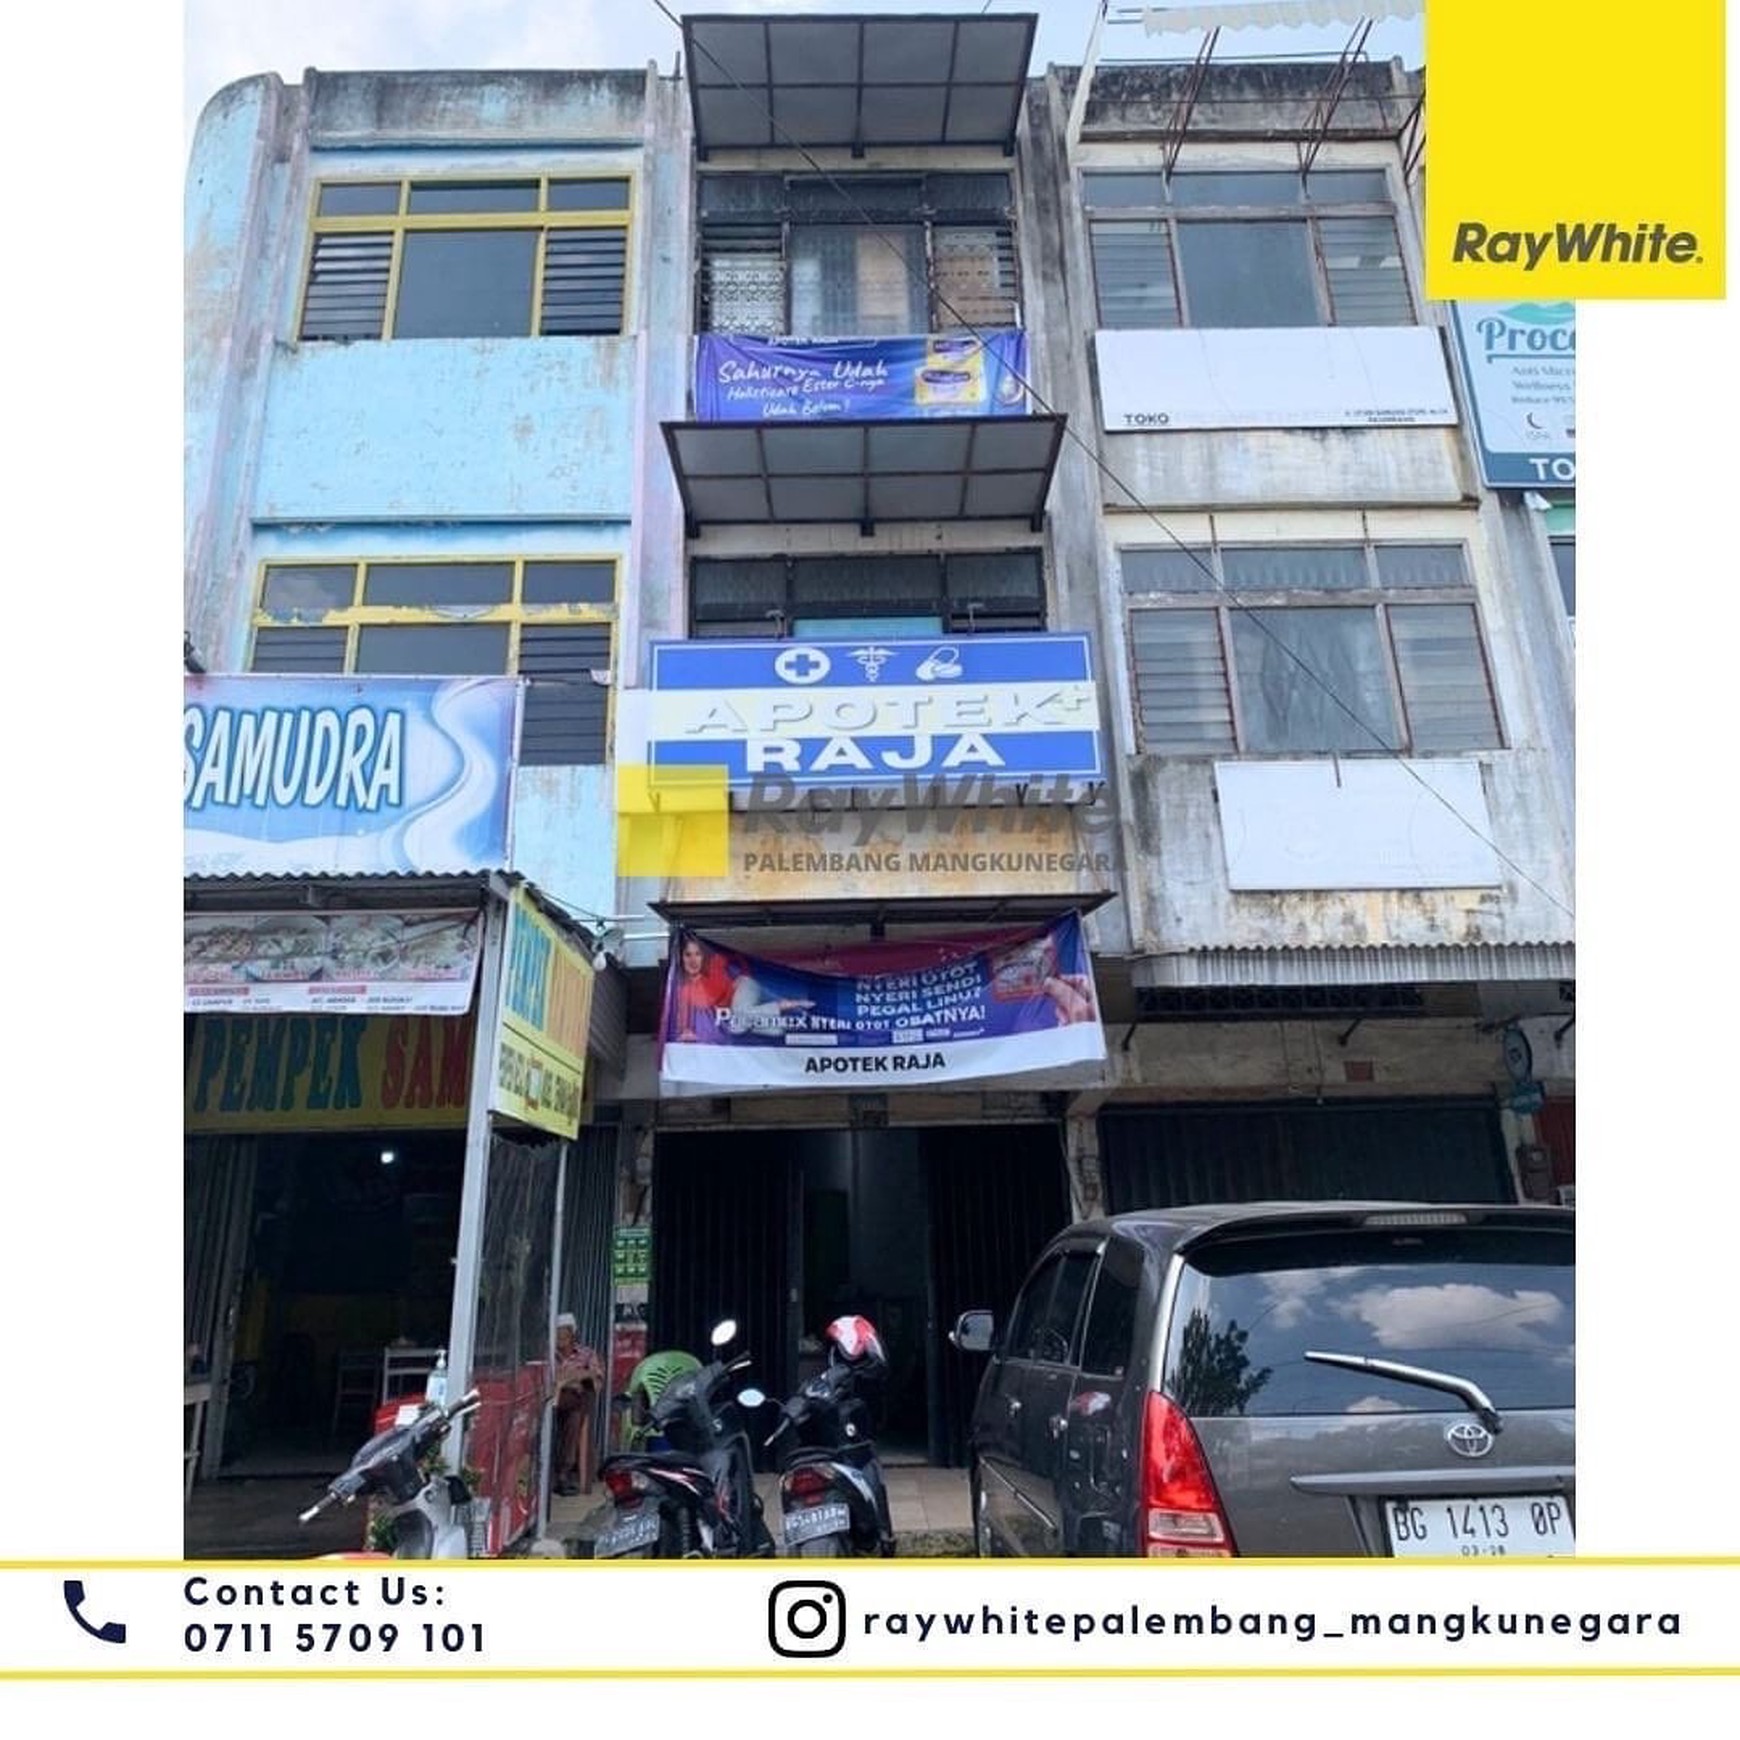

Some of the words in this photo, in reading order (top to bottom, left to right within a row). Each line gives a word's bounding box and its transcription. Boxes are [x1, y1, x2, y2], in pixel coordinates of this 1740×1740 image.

[1477, 317, 1576, 351] Proc
[833, 360, 888, 378] Udah
[1124, 412, 1169, 425] TOKO
[746, 733, 1006, 772] RAJA
[855, 986, 919, 1004] NYERI
[856, 1000, 922, 1017] PEGAL
[193, 1016, 367, 1112] PEMPEK
[804, 1053, 888, 1074] APOTEK
[892, 1050, 946, 1071] RAJA
[1393, 1506, 1427, 1542] BG
[1446, 1504, 1509, 1540] 1413
